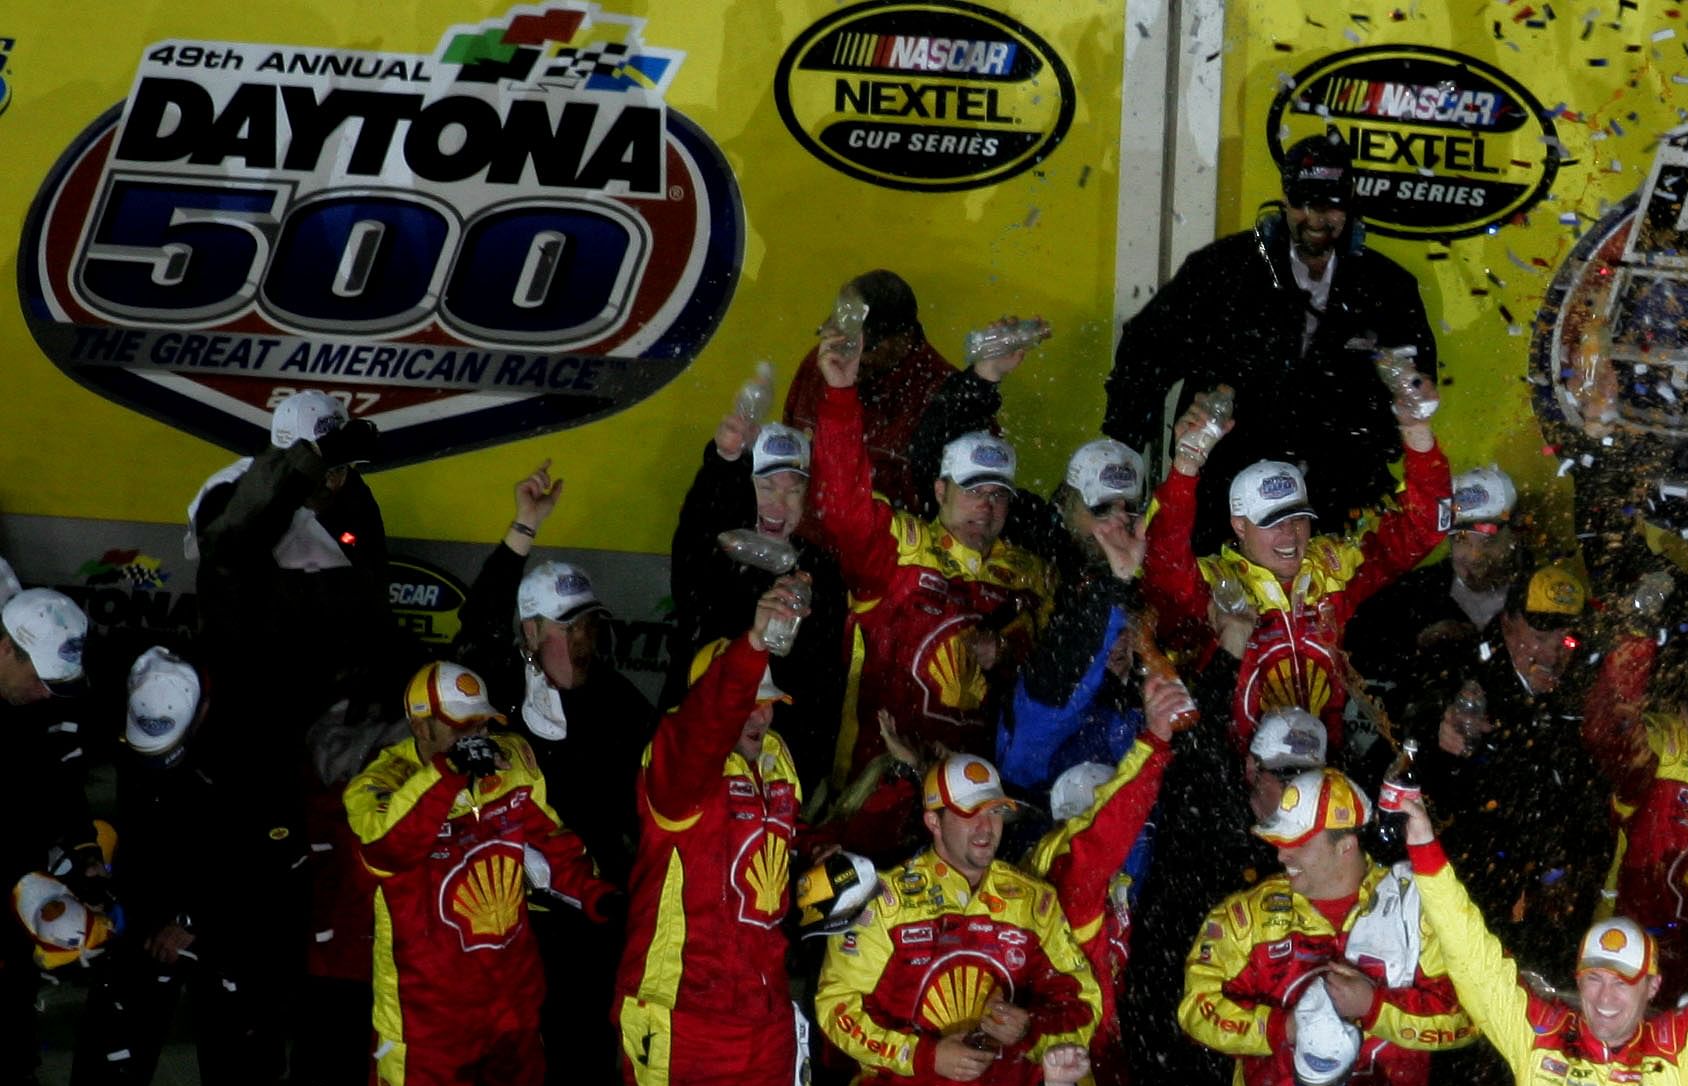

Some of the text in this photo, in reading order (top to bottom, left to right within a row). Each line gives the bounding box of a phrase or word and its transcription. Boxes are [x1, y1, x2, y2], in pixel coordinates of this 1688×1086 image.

[148, 46, 430, 82] 49th ANNUAL
[889, 34, 1010, 74] NASCAR
[835, 78, 1013, 124] NEXTEL
[1380, 80, 1495, 126] NASCAR
[116, 78, 664, 193] DAYTONA
[849, 128, 1000, 157] CUP SERIES
[1352, 176, 1487, 207] UP SERIES
[78, 172, 652, 346] 500
[70, 330, 600, 391] THE GREAT AMERICAN RACE
[266, 388, 380, 412] 27
[837, 1015, 897, 1059] Shell
[1418, 1024, 1476, 1044] She
